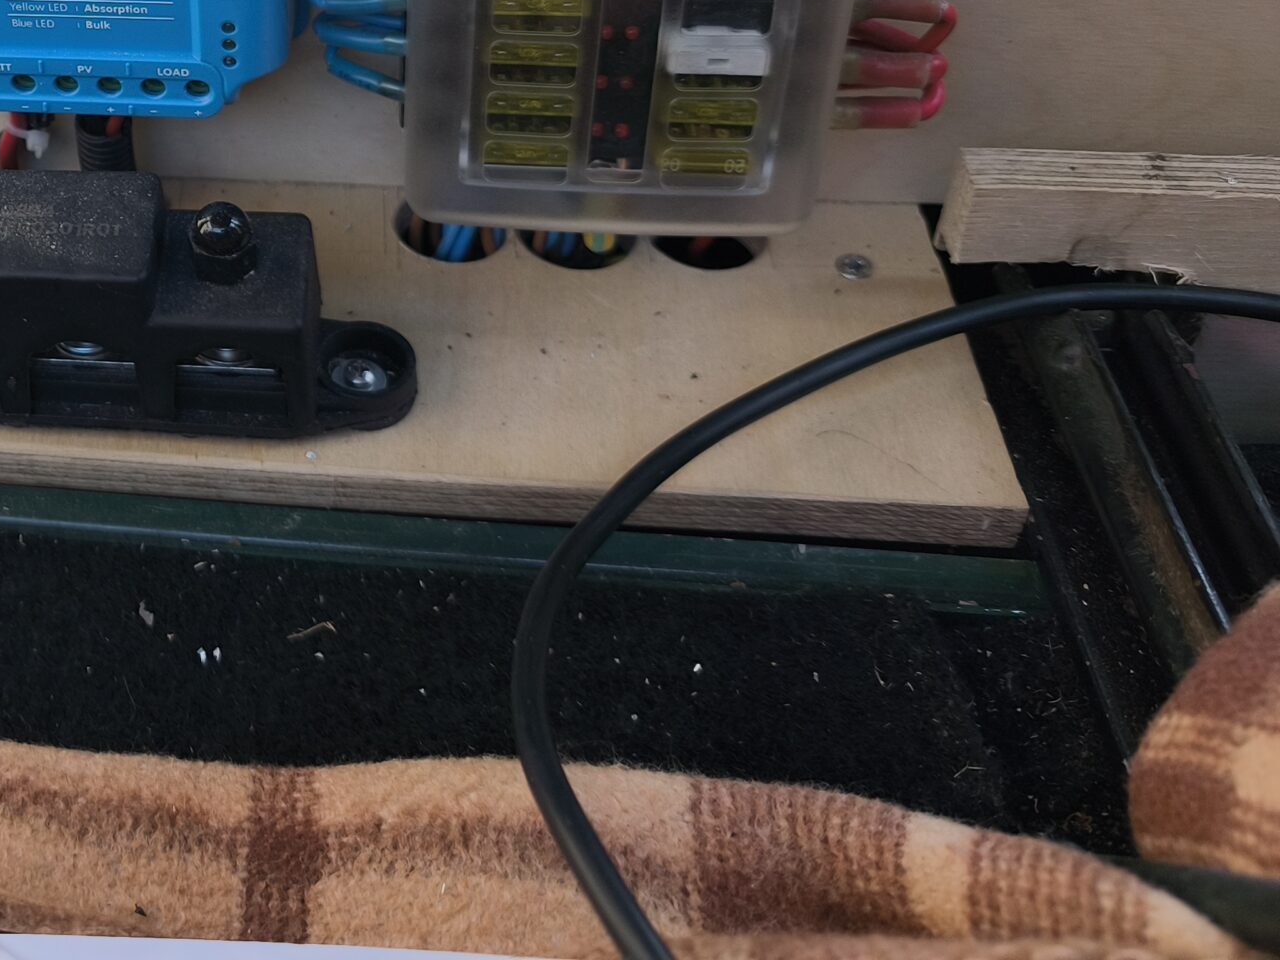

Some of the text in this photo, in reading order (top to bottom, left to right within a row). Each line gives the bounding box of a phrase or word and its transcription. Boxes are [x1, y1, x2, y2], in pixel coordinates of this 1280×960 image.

[9, 2, 148, 15] Yellow LED Absorption
[11, 18, 111, 29] Blue LED Bulk
[76, 65, 93, 74] PV
[156, 67, 190, 77] LOAD
